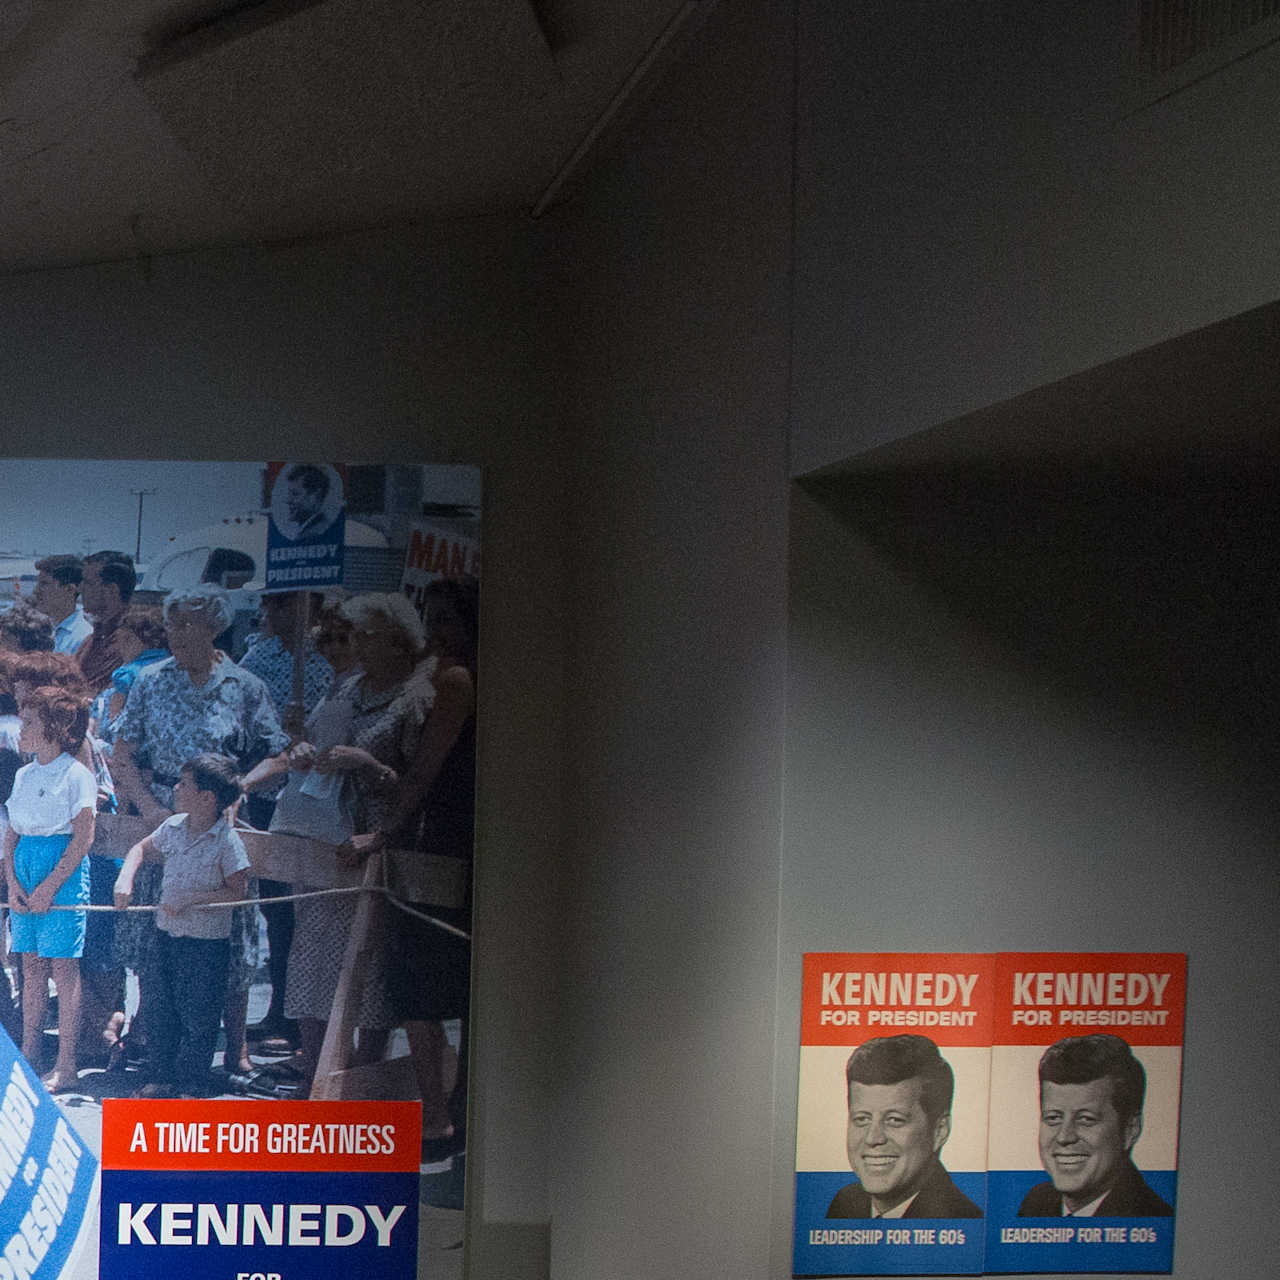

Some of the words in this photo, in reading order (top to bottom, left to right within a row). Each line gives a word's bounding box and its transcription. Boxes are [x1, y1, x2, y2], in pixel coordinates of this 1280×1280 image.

[268, 543, 339, 561] KENNEDY
[267, 565, 341, 582] PRESIDENT
[821, 972, 979, 1006] KENNEDY
[1013, 972, 1171, 1006] KENNEDY
[820, 1011, 861, 1026] FOR
[867, 1010, 977, 1027] PRESIDENT
[1012, 1010, 1053, 1026] FOR
[1059, 1010, 1169, 1027] PRESIDENT
[130, 1122, 147, 1153] A
[154, 1122, 210, 1153] TIME
[216, 1123, 259, 1154] FOR
[267, 1124, 396, 1155] GREATNESS
[117, 1203, 407, 1247] KENNEDY
[809, 1229, 883, 1245] LEADERSHIP
[885, 1230, 911, 1245] FOR
[913, 1229, 936, 1245] THE
[1001, 1227, 1075, 1243] LEADERSHIP
[1077, 1228, 1102, 1243] FOR
[1104, 1228, 1127, 1243] THE
